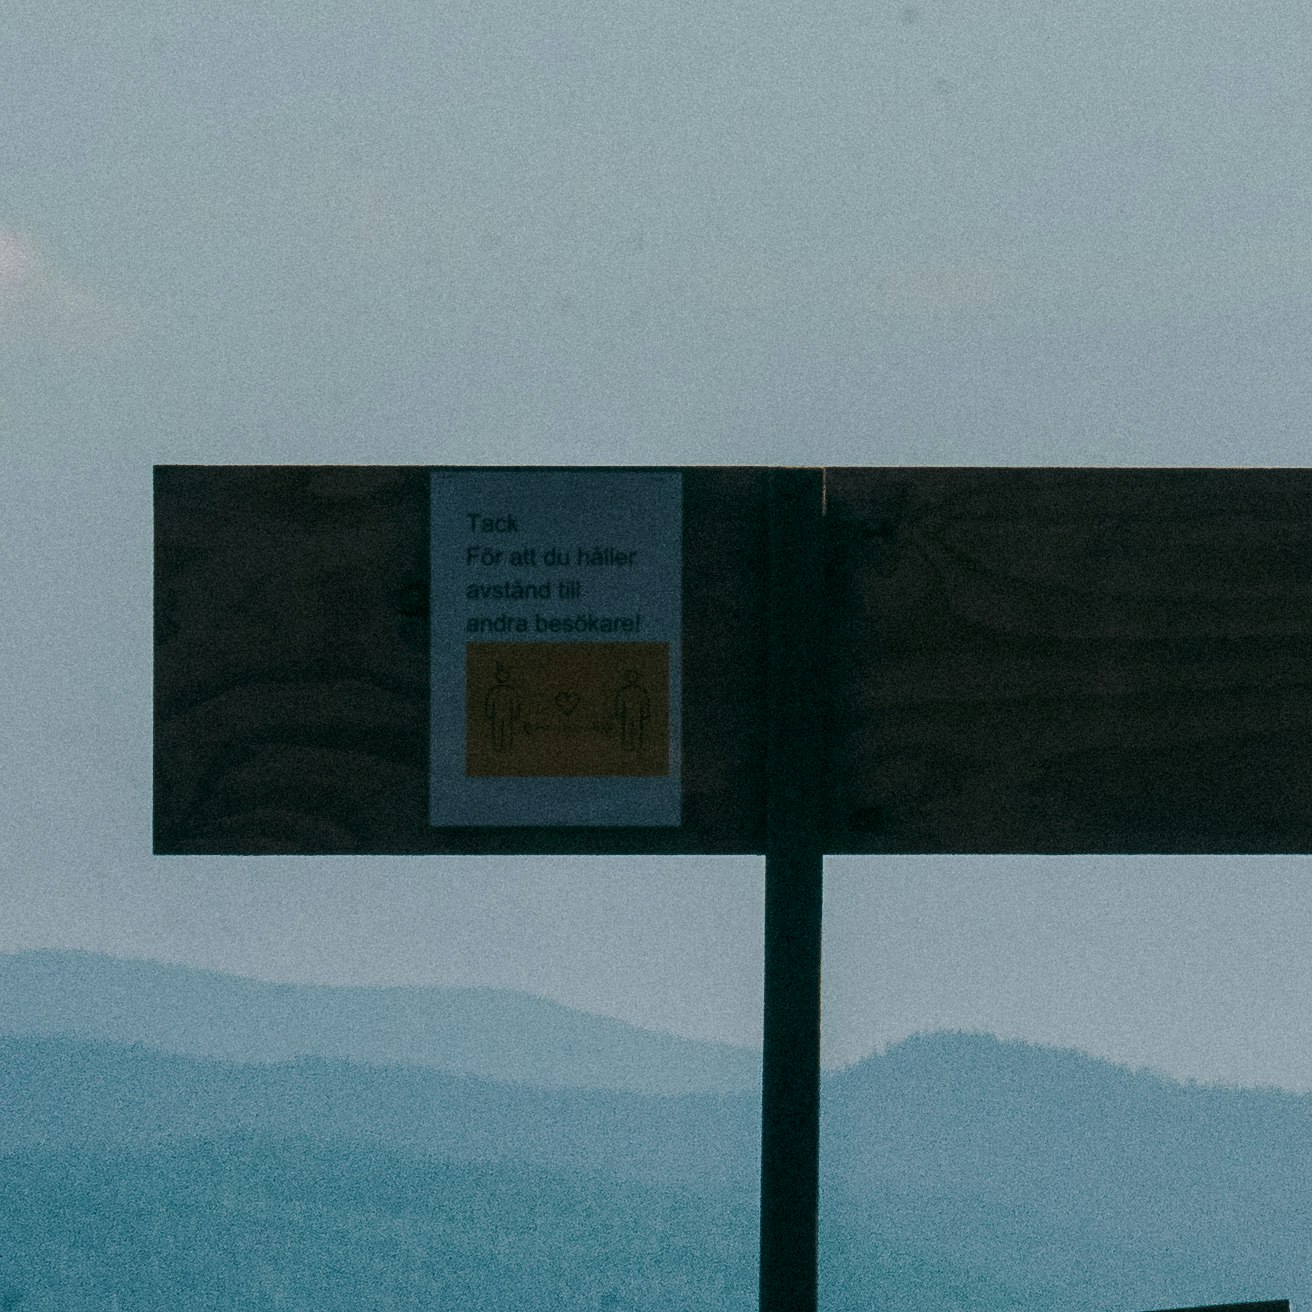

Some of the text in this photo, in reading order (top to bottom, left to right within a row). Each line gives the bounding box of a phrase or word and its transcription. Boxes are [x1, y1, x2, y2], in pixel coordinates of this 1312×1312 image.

[467, 513, 518, 534] Tack
[466, 547, 637, 567] För att du håller
[466, 581, 581, 600] avstånd till
[466, 613, 641, 633] andra besökare!
